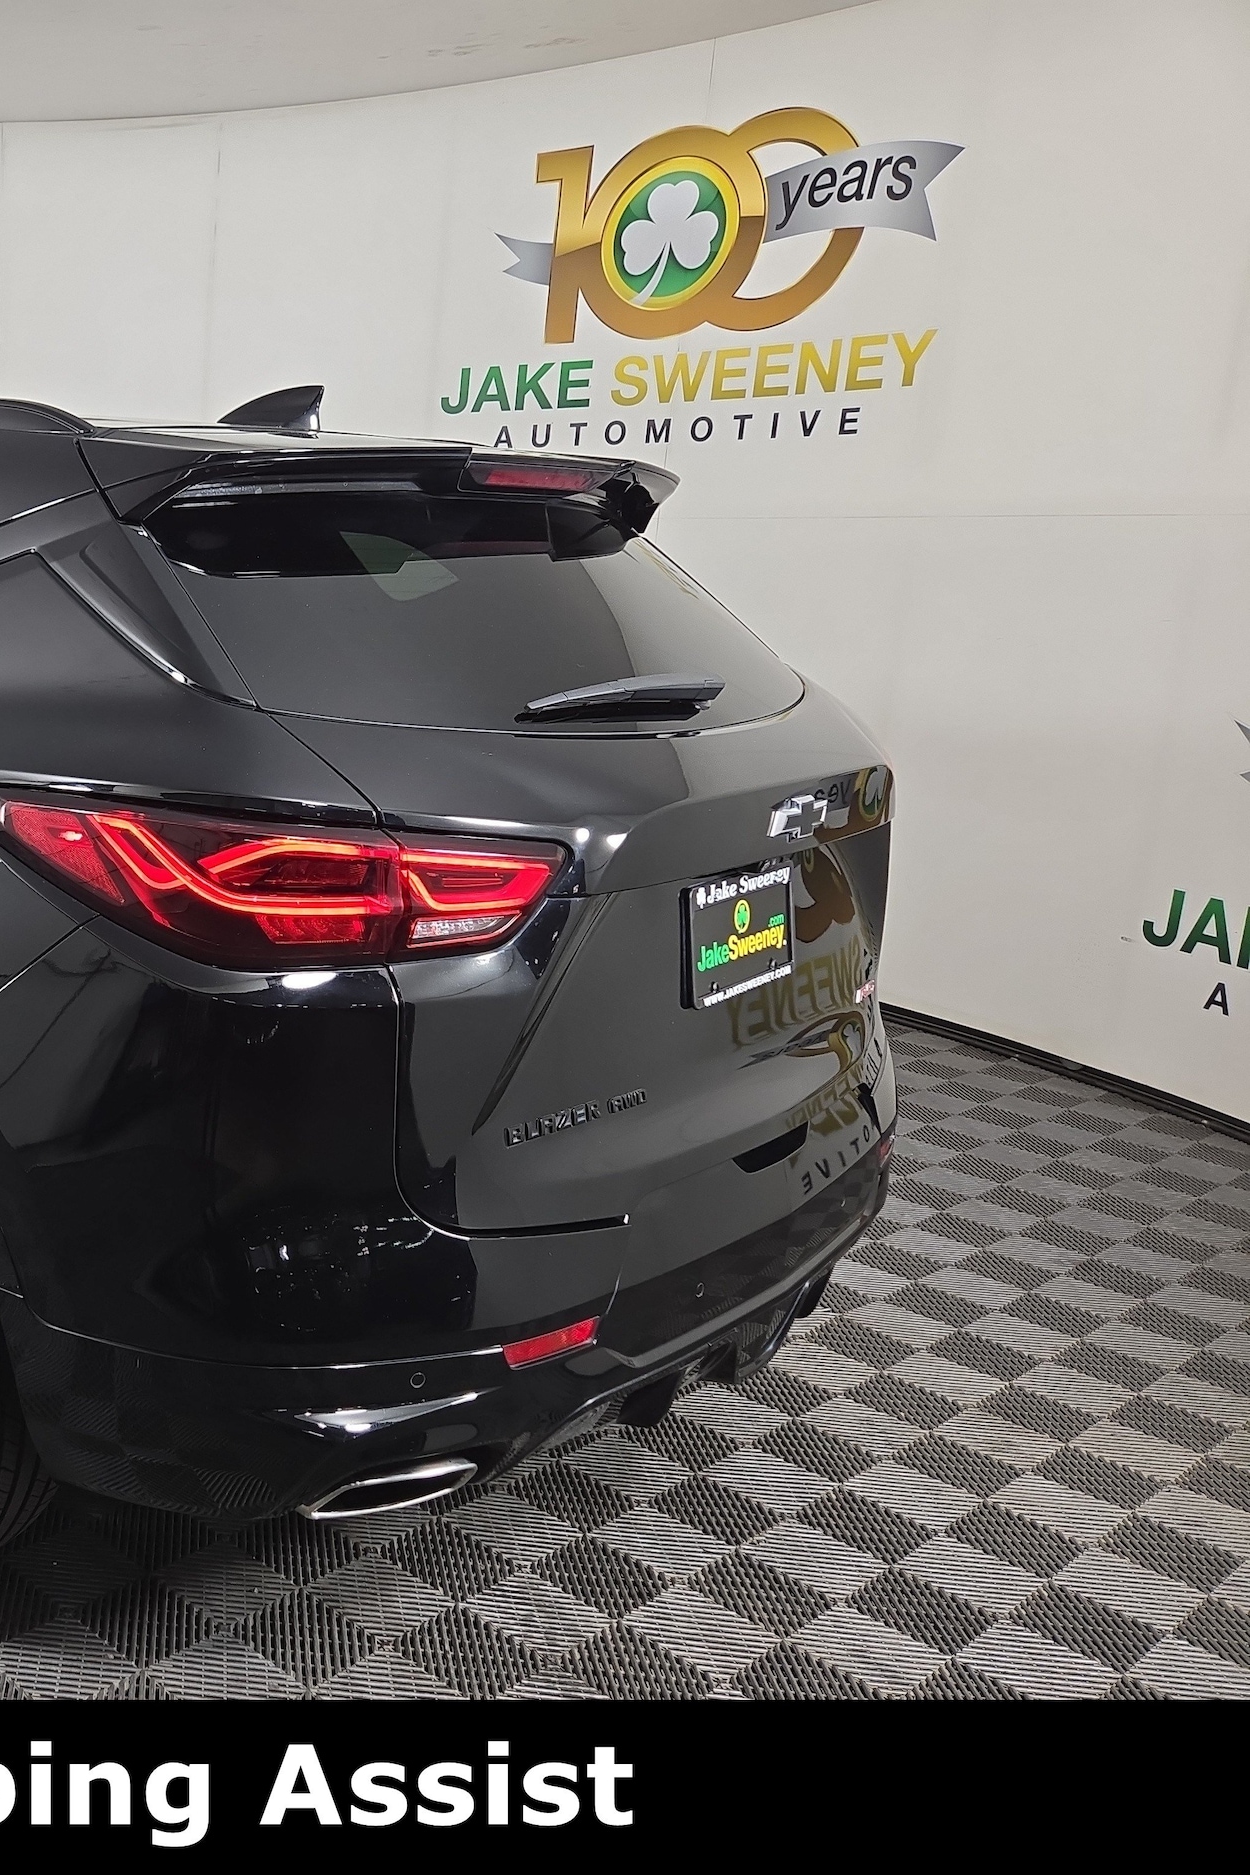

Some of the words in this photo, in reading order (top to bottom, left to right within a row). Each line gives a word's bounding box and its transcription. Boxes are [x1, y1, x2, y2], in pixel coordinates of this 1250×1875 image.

[536, 106, 866, 345] 100
[775, 153, 917, 232] years
[440, 359, 594, 415] JAKE
[610, 328, 938, 408] SWEENEY
[494, 406, 862, 449] AUTOMOTIVE
[707, 880, 737, 904] Jake
[739, 866, 791, 894] Sweeney
[1142, 888, 1250, 970] JA
[703, 964, 792, 1008] WWW.JAKESWEENEY.COM
[503, 1100, 601, 1149] BLAZER
[606, 1087, 648, 1114] AWD
